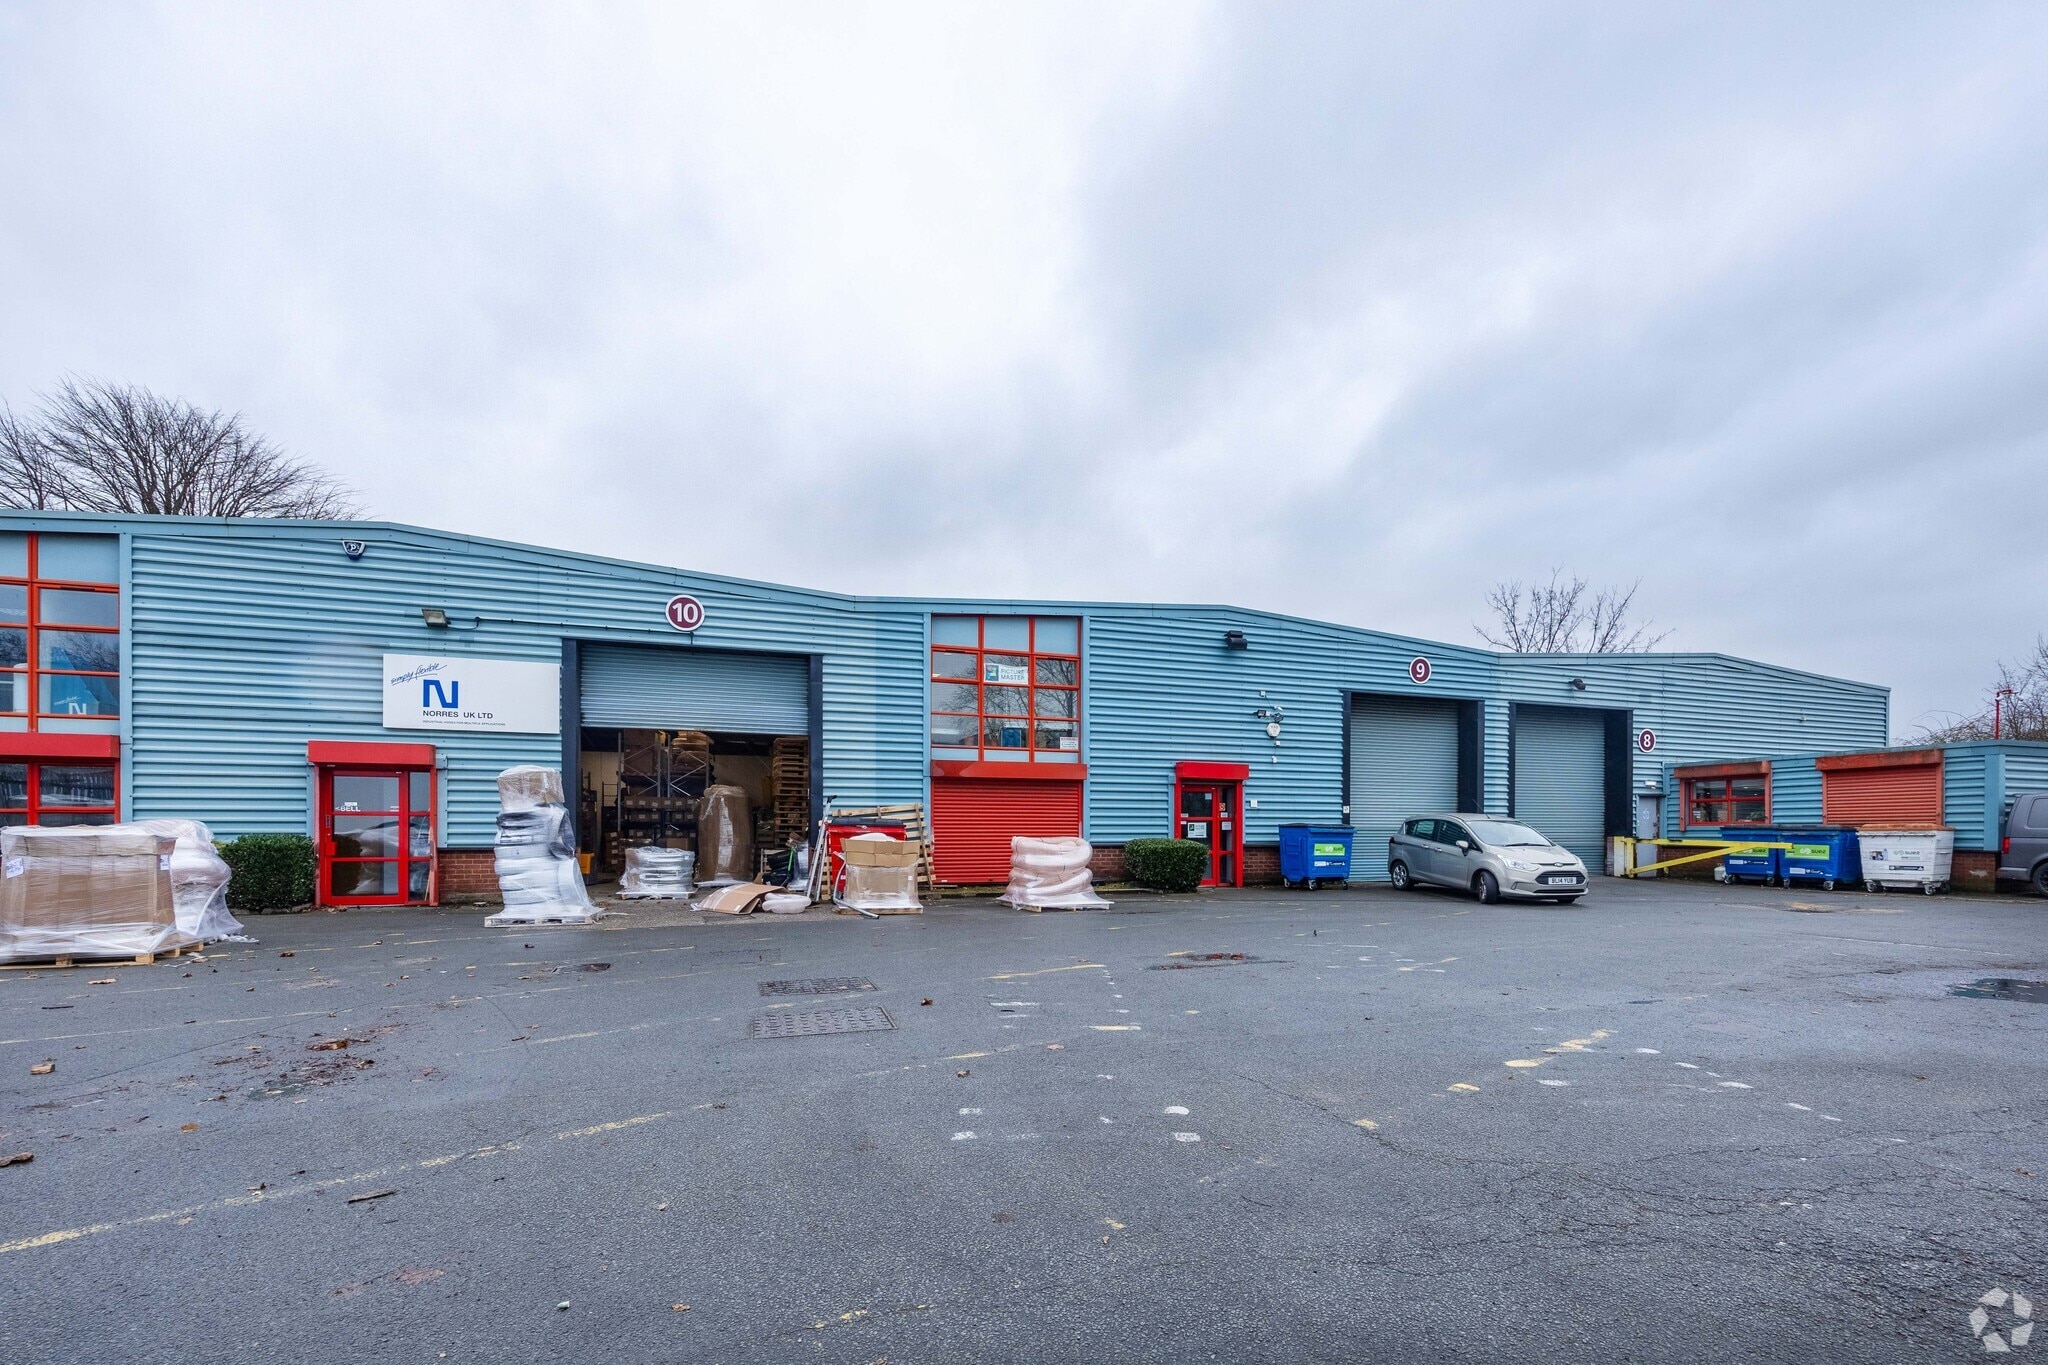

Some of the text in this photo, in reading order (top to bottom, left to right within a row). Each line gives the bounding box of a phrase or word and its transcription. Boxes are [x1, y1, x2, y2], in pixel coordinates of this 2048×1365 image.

[672, 602, 698, 623] 10
[391, 663, 447, 684] simply flexible
[1416, 662, 1425, 677] 9
[423, 679, 458, 708] N
[423, 710, 459, 718] NORRES
[1643, 734, 1651, 747] 8
